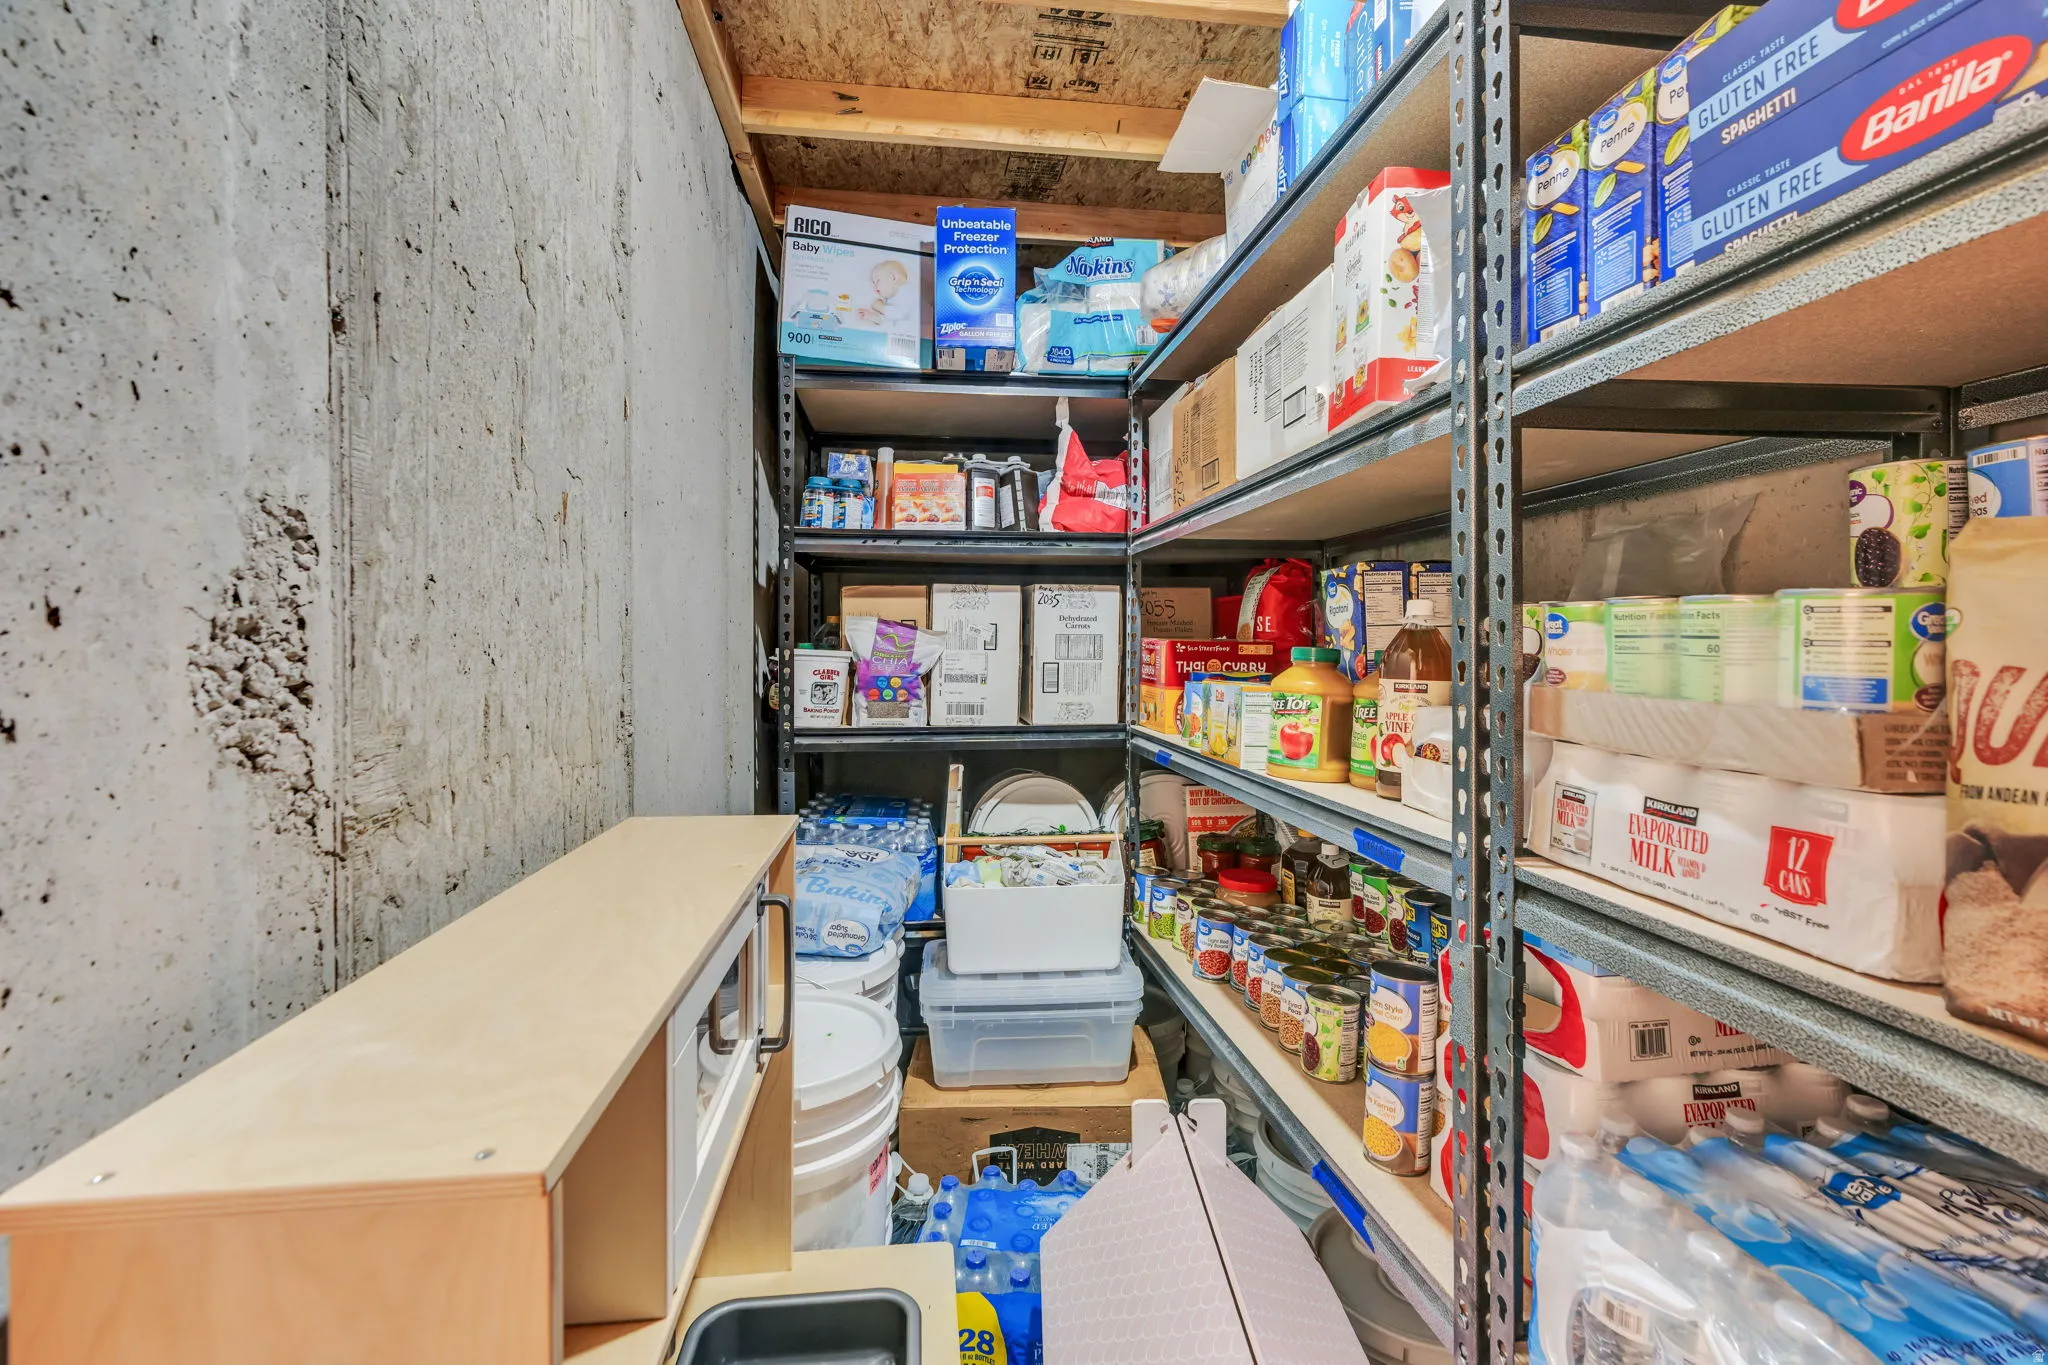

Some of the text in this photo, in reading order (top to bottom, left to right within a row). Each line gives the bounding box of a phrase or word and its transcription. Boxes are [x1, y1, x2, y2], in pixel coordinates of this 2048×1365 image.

[1722, 35, 1786, 83] CLASSIC TASTE
[1279, 48, 1289, 101] Ziploc
[1698, 70, 1766, 130] GLUTEN
[1773, 34, 1820, 82] FREE
[1861, 55, 2003, 151] Barilla
[1720, 87, 1797, 145] SPAGHETTI
[1600, 121, 1635, 153] Penne
[1277, 145, 1288, 199] Ziploc
[1726, 158, 1791, 198] CLASSIC TASTE
[1537, 166, 1570, 195] Penne
[1701, 162, 1823, 241] GLUTEN FREE
[793, 216, 831, 237] RICO
[941, 219, 1012, 231] Unbeatable
[953, 231, 1000, 242] Freezer
[792, 241, 820, 255] Baby
[822, 244, 855, 258] Wipes
[943, 243, 1007, 255] Protection
[949, 277, 1004, 288] Grip'n Seal
[955, 286, 999, 296] Technology
[940, 321, 968, 335] Ziploc
[787, 331, 811, 345] 900
[1037, 591, 1063, 608] 2035
[1328, 602, 1350, 617] Rigatoni
[1696, 611, 1721, 620] Facts
[1059, 615, 1098, 624] Dehydrated
[1613, 613, 1647, 621] Nutrition
[1706, 644, 1721, 653] 60
[871, 656, 909, 665] CHIA
[1222, 661, 1267, 673] CURRY
[812, 668, 841, 677] CLABBER
[1355, 704, 1377, 719] TREE
[1384, 712, 1408, 721] APPLE
[1384, 720, 1414, 734] VINE
[1189, 789, 1203, 798] WHY
[1563, 789, 1587, 801] KIRKLAND
[1960, 784, 2040, 805] FROM ANDEAN
[1189, 797, 1202, 806] OUT
[1202, 797, 1211, 806] OF
[1556, 798, 1589, 818] EVAPORATED
[1645, 798, 1698, 819] KIRKLAND
[1556, 810, 1576, 829] MILK
[1628, 812, 1710, 855] EVAPORATED
[1629, 837, 1676, 878] MILK
[1787, 835, 1811, 874] 12
[1778, 869, 1811, 899] CANS
[828, 923, 849, 933] Sugar
[1804, 916, 1831, 930] Free
[827, 931, 867, 943] Granulated
[1287, 1000, 1303, 1009] Eyed
[1287, 1006, 1302, 1016] Peas
[1384, 1002, 1404, 1014] Style
[1385, 1011, 1403, 1021] Corn
[1694, 1083, 1739, 1095] KIRKLAND
[1373, 1100, 1397, 1114] Kernel
[996, 1142, 1068, 1160] WHEAT
[1040, 1161, 1068, 1170] ARD
[959, 1328, 995, 1356] 28
[974, 1353, 996, 1365] BOTTLES
